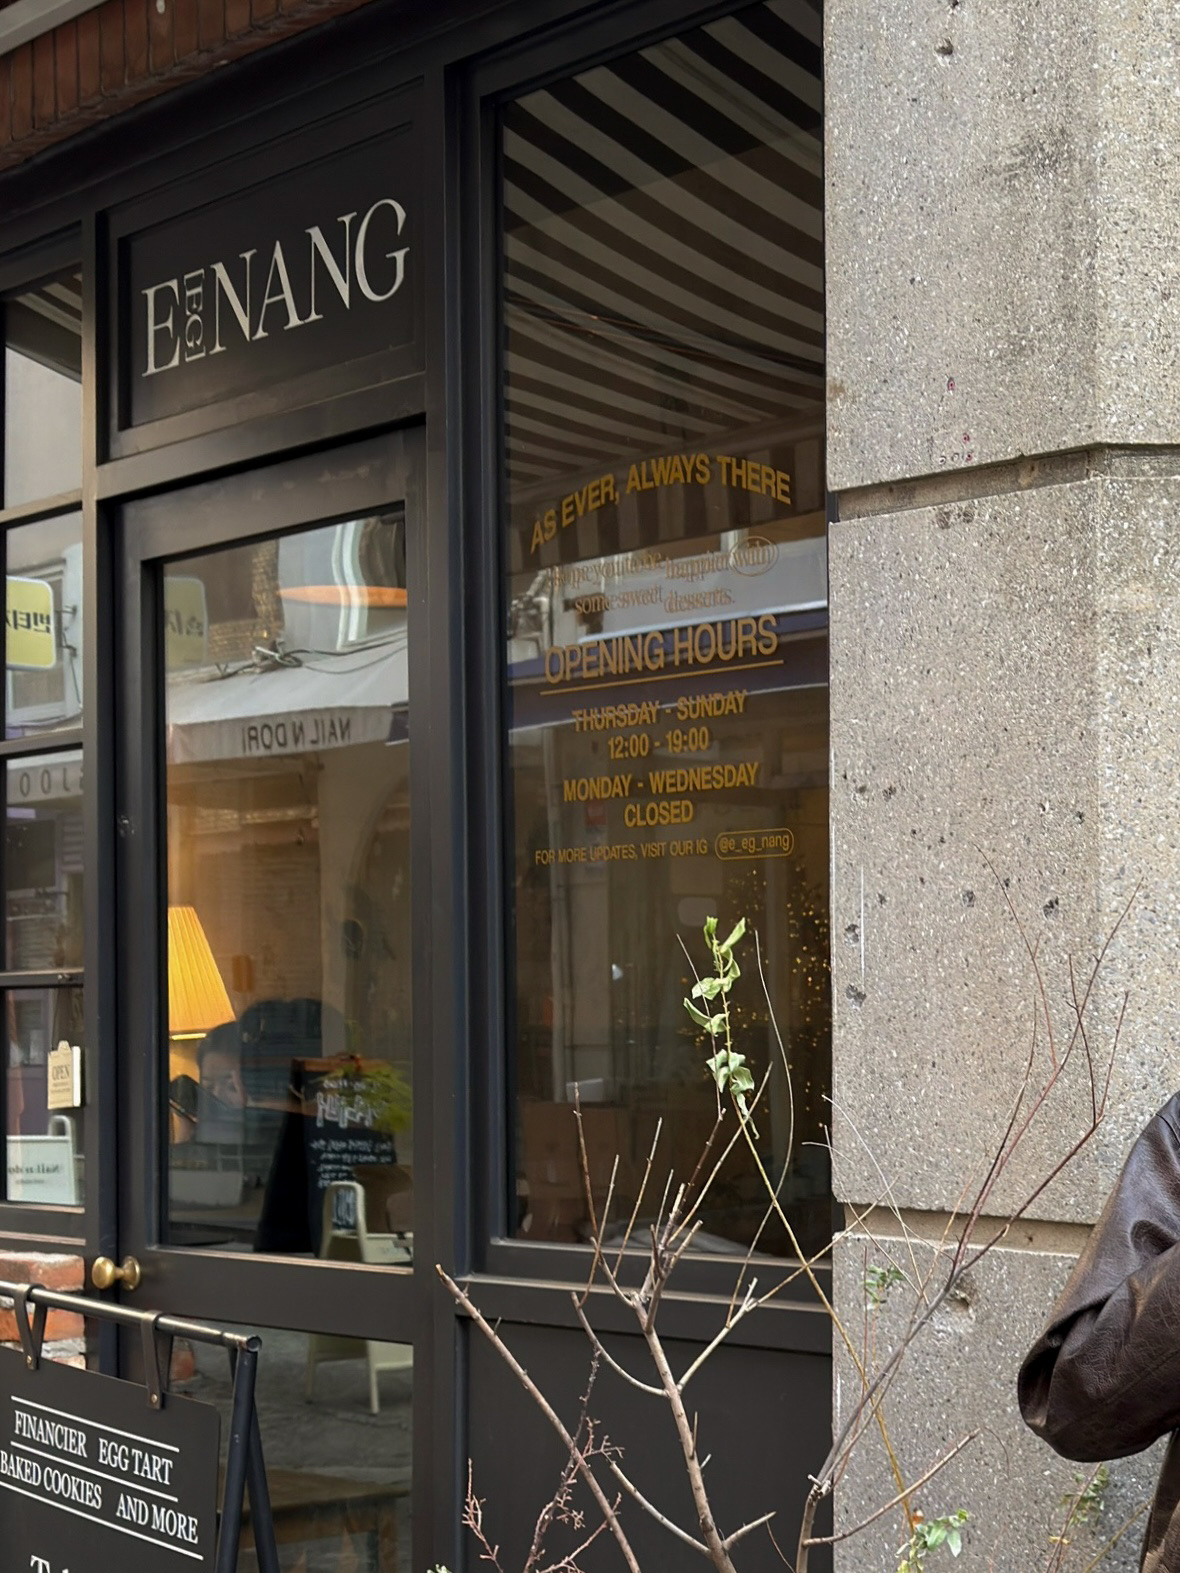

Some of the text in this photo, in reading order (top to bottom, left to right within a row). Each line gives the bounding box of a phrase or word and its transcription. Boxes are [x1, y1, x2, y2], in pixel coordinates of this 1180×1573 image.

[531, 454, 791, 553] AS EVER, ALWAYS THERE
[544, 614, 779, 684] OPENING HOURS
[572, 699, 661, 732] THURSDAY
[676, 689, 749, 721] SUNDAY
[608, 733, 650, 759] 12:00
[666, 726, 709, 755] 19:00
[563, 775, 632, 801] MONDAY
[649, 762, 759, 795] WEDNESDAY
[624, 800, 694, 828] CLOSED
[535, 849, 555, 865] FOR
[558, 846, 587, 863] MORE
[589, 842, 638, 863] UPDATES,
[640, 841, 669, 858] VISIT
[671, 839, 693, 856] OUR
[696, 839, 708, 854] IG
[14, 1409, 173, 1485] FINANCIER EGG TART
[0, 1452, 198, 1544] BAKED COOKIES AND MORE
